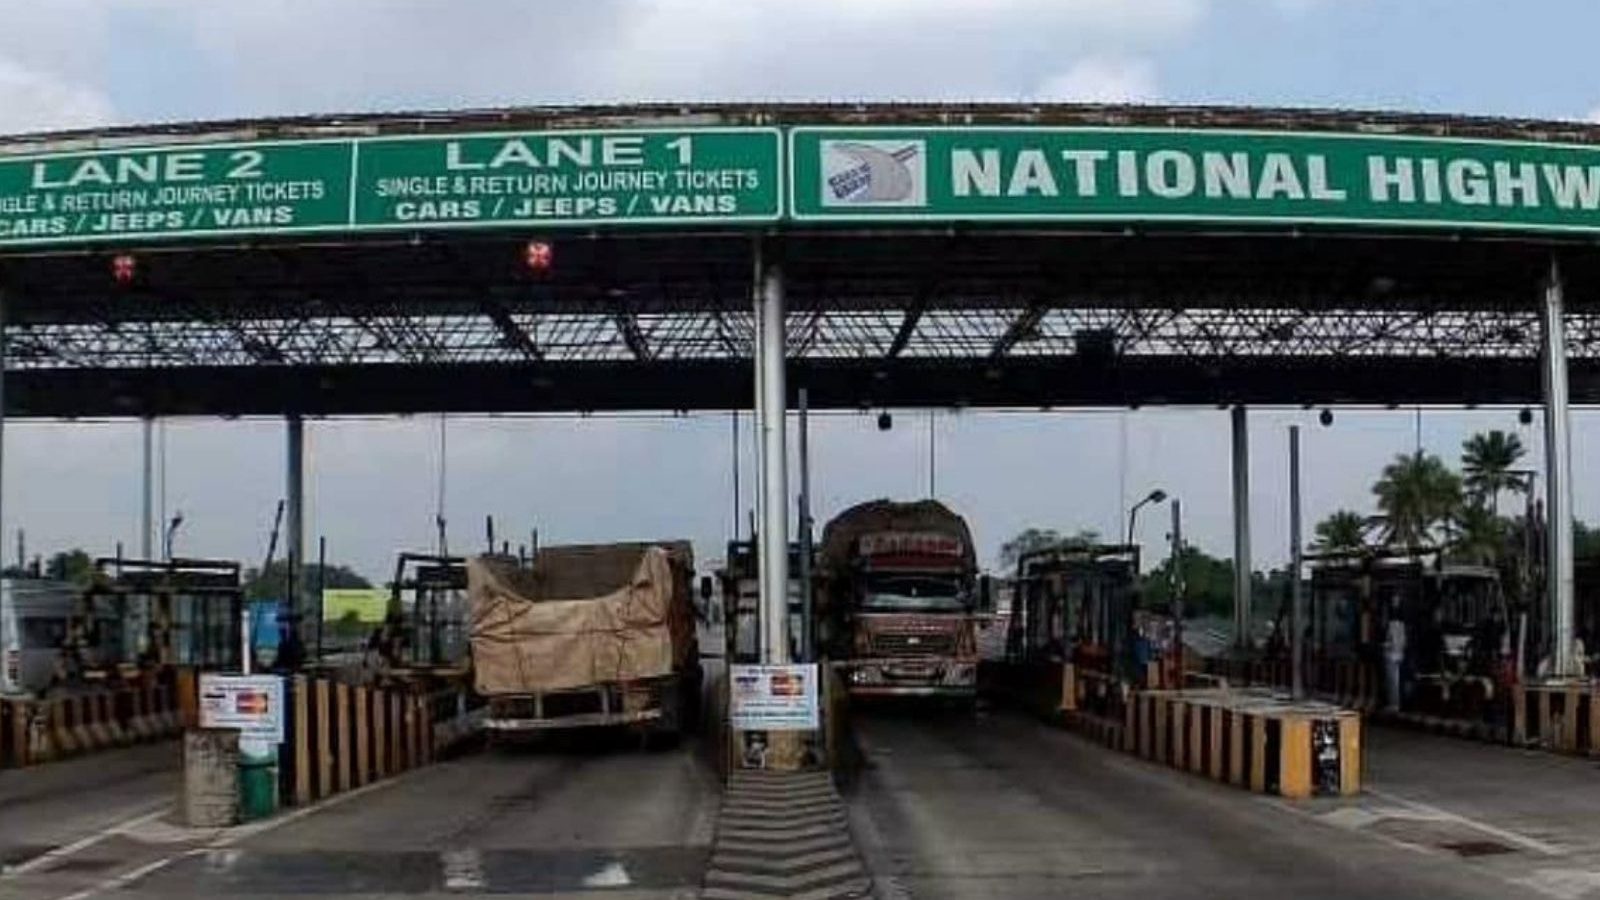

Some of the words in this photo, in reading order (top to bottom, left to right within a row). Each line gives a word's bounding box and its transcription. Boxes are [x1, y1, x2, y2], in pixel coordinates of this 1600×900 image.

[447, 137, 644, 170] LANE
[666, 136, 692, 165] 1
[33, 154, 205, 188] LANE
[226, 151, 264, 178] 2
[376, 176, 449, 196] SINGLE
[452, 176, 467, 194] &
[470, 174, 567, 194] RETURN
[573, 171, 668, 192] JOURNEY
[675, 169, 759, 190] TICKETS
[951, 149, 1346, 200] NATIONAL
[1368, 155, 1600, 209] HIGHW
[61, 189, 147, 212] RETURN
[152, 184, 240, 206] JOURNEY
[247, 180, 325, 201] TICKETS
[396, 200, 481, 220] CARS
[492, 197, 504, 217] /
[514, 197, 618, 216] JEEPS
[627, 195, 639, 215] /
[652, 195, 737, 213] VANS
[0, 217, 66, 236] CARS
[74, 213, 87, 233] /
[92, 210, 184, 231] JEEPS
[189, 207, 204, 227] /
[213, 205, 294, 226] VANS
